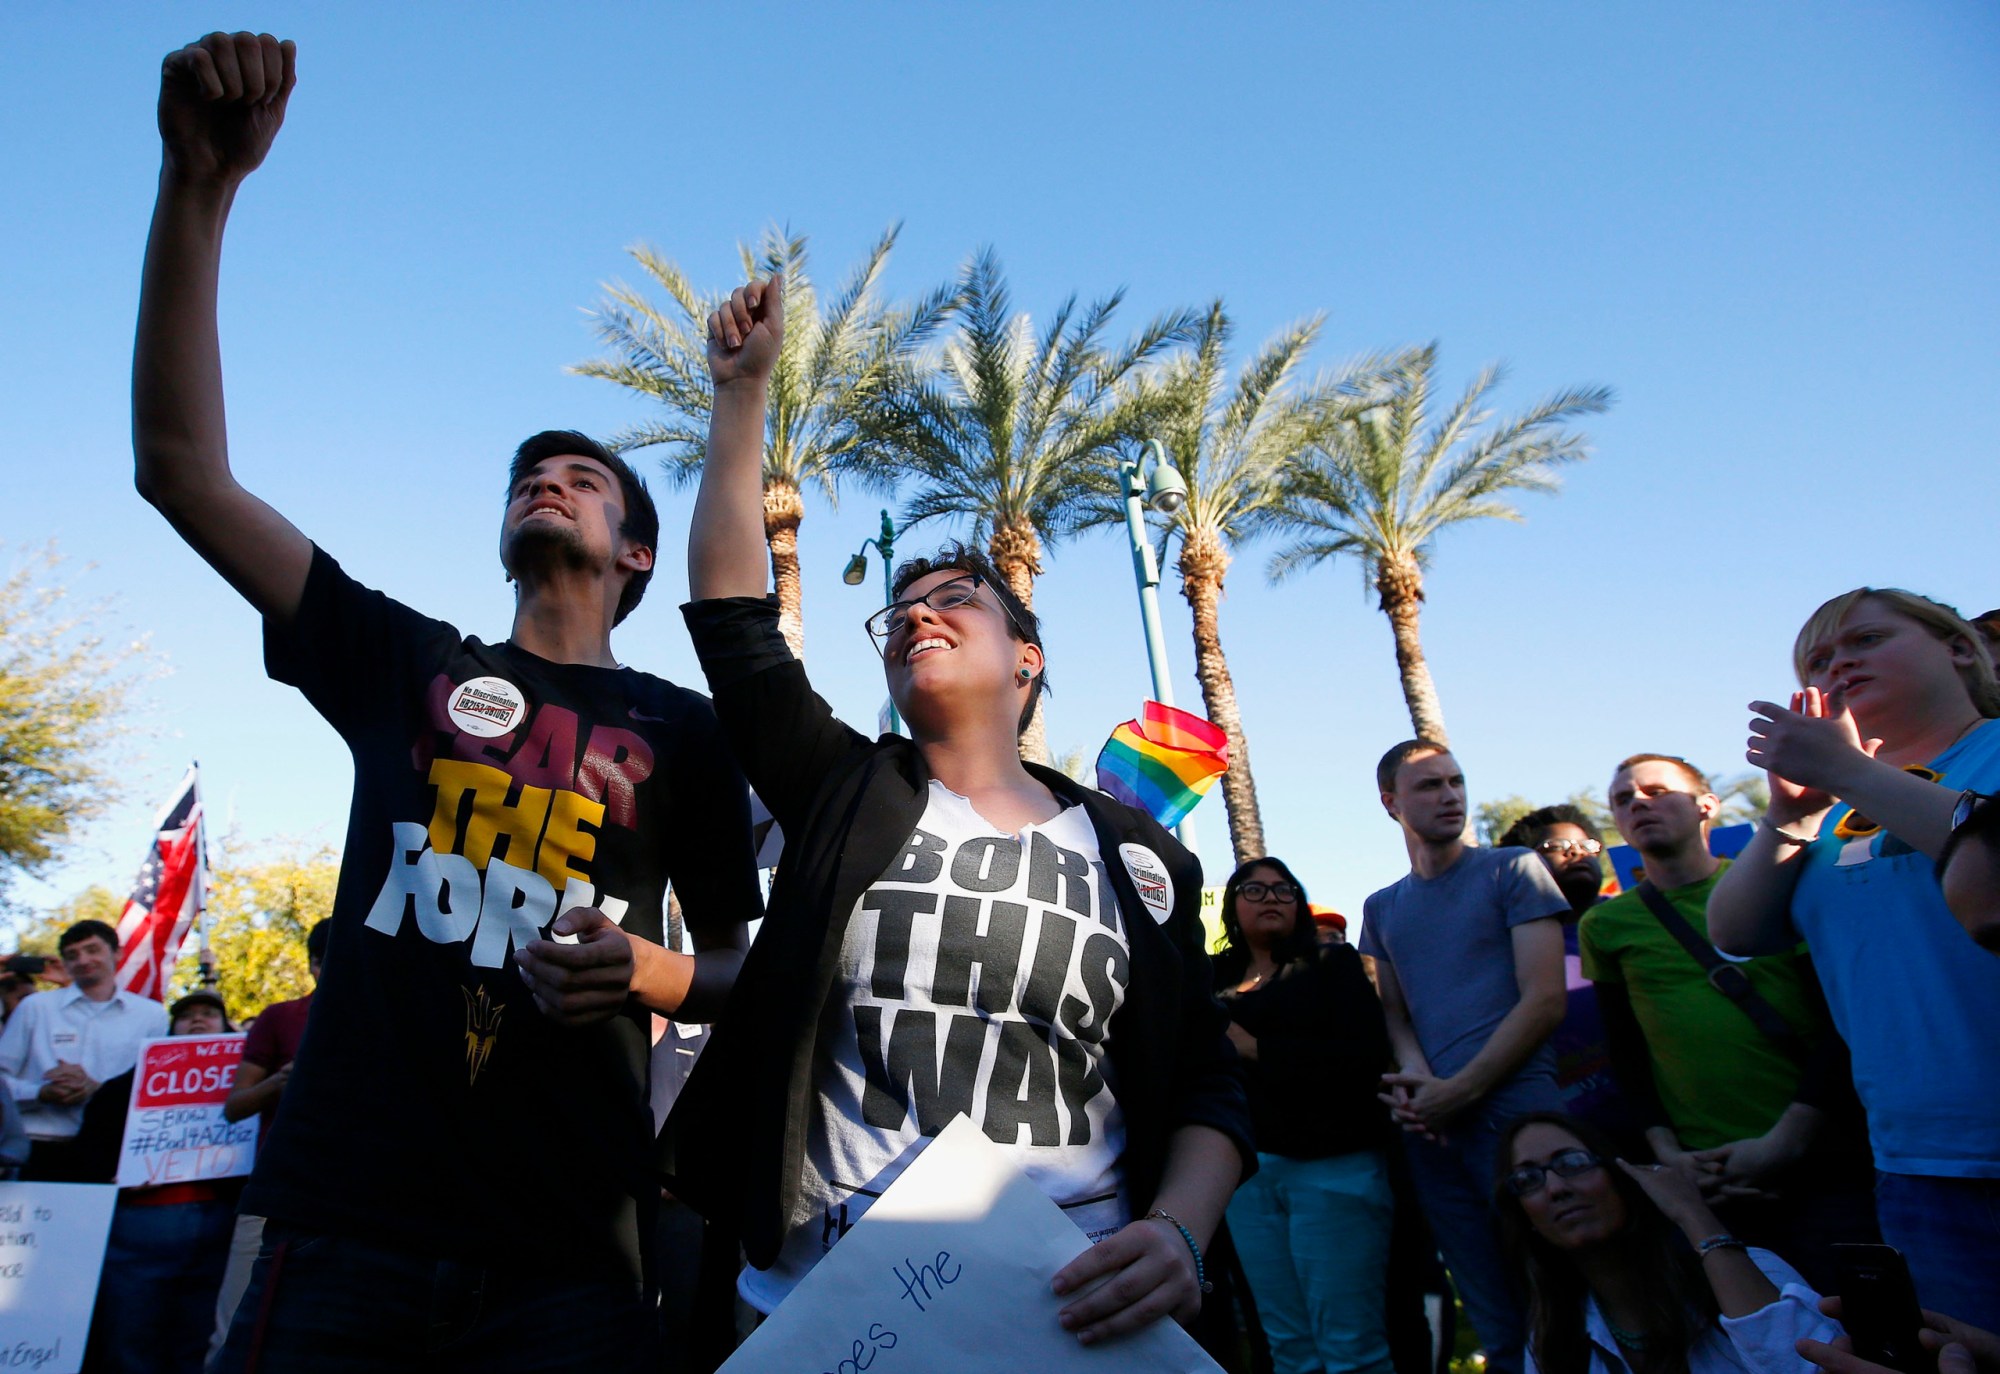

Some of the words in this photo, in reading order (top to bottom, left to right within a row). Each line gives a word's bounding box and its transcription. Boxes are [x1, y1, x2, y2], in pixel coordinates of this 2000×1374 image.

[459, 697, 511, 722] HB2153/SB1062
[463, 686, 473, 694] No
[473, 688, 519, 708] Discrimination
[428, 758, 606, 890] THE
[862, 890, 1129, 1043] THIS
[196, 1041, 243, 1056] WE'RE
[853, 1006, 1104, 1146] WAY
[144, 1144, 236, 1183] VETO
[34, 1205, 52, 1222] to
[892, 1251, 962, 1312] the
[822, 1323, 898, 1374] oes
